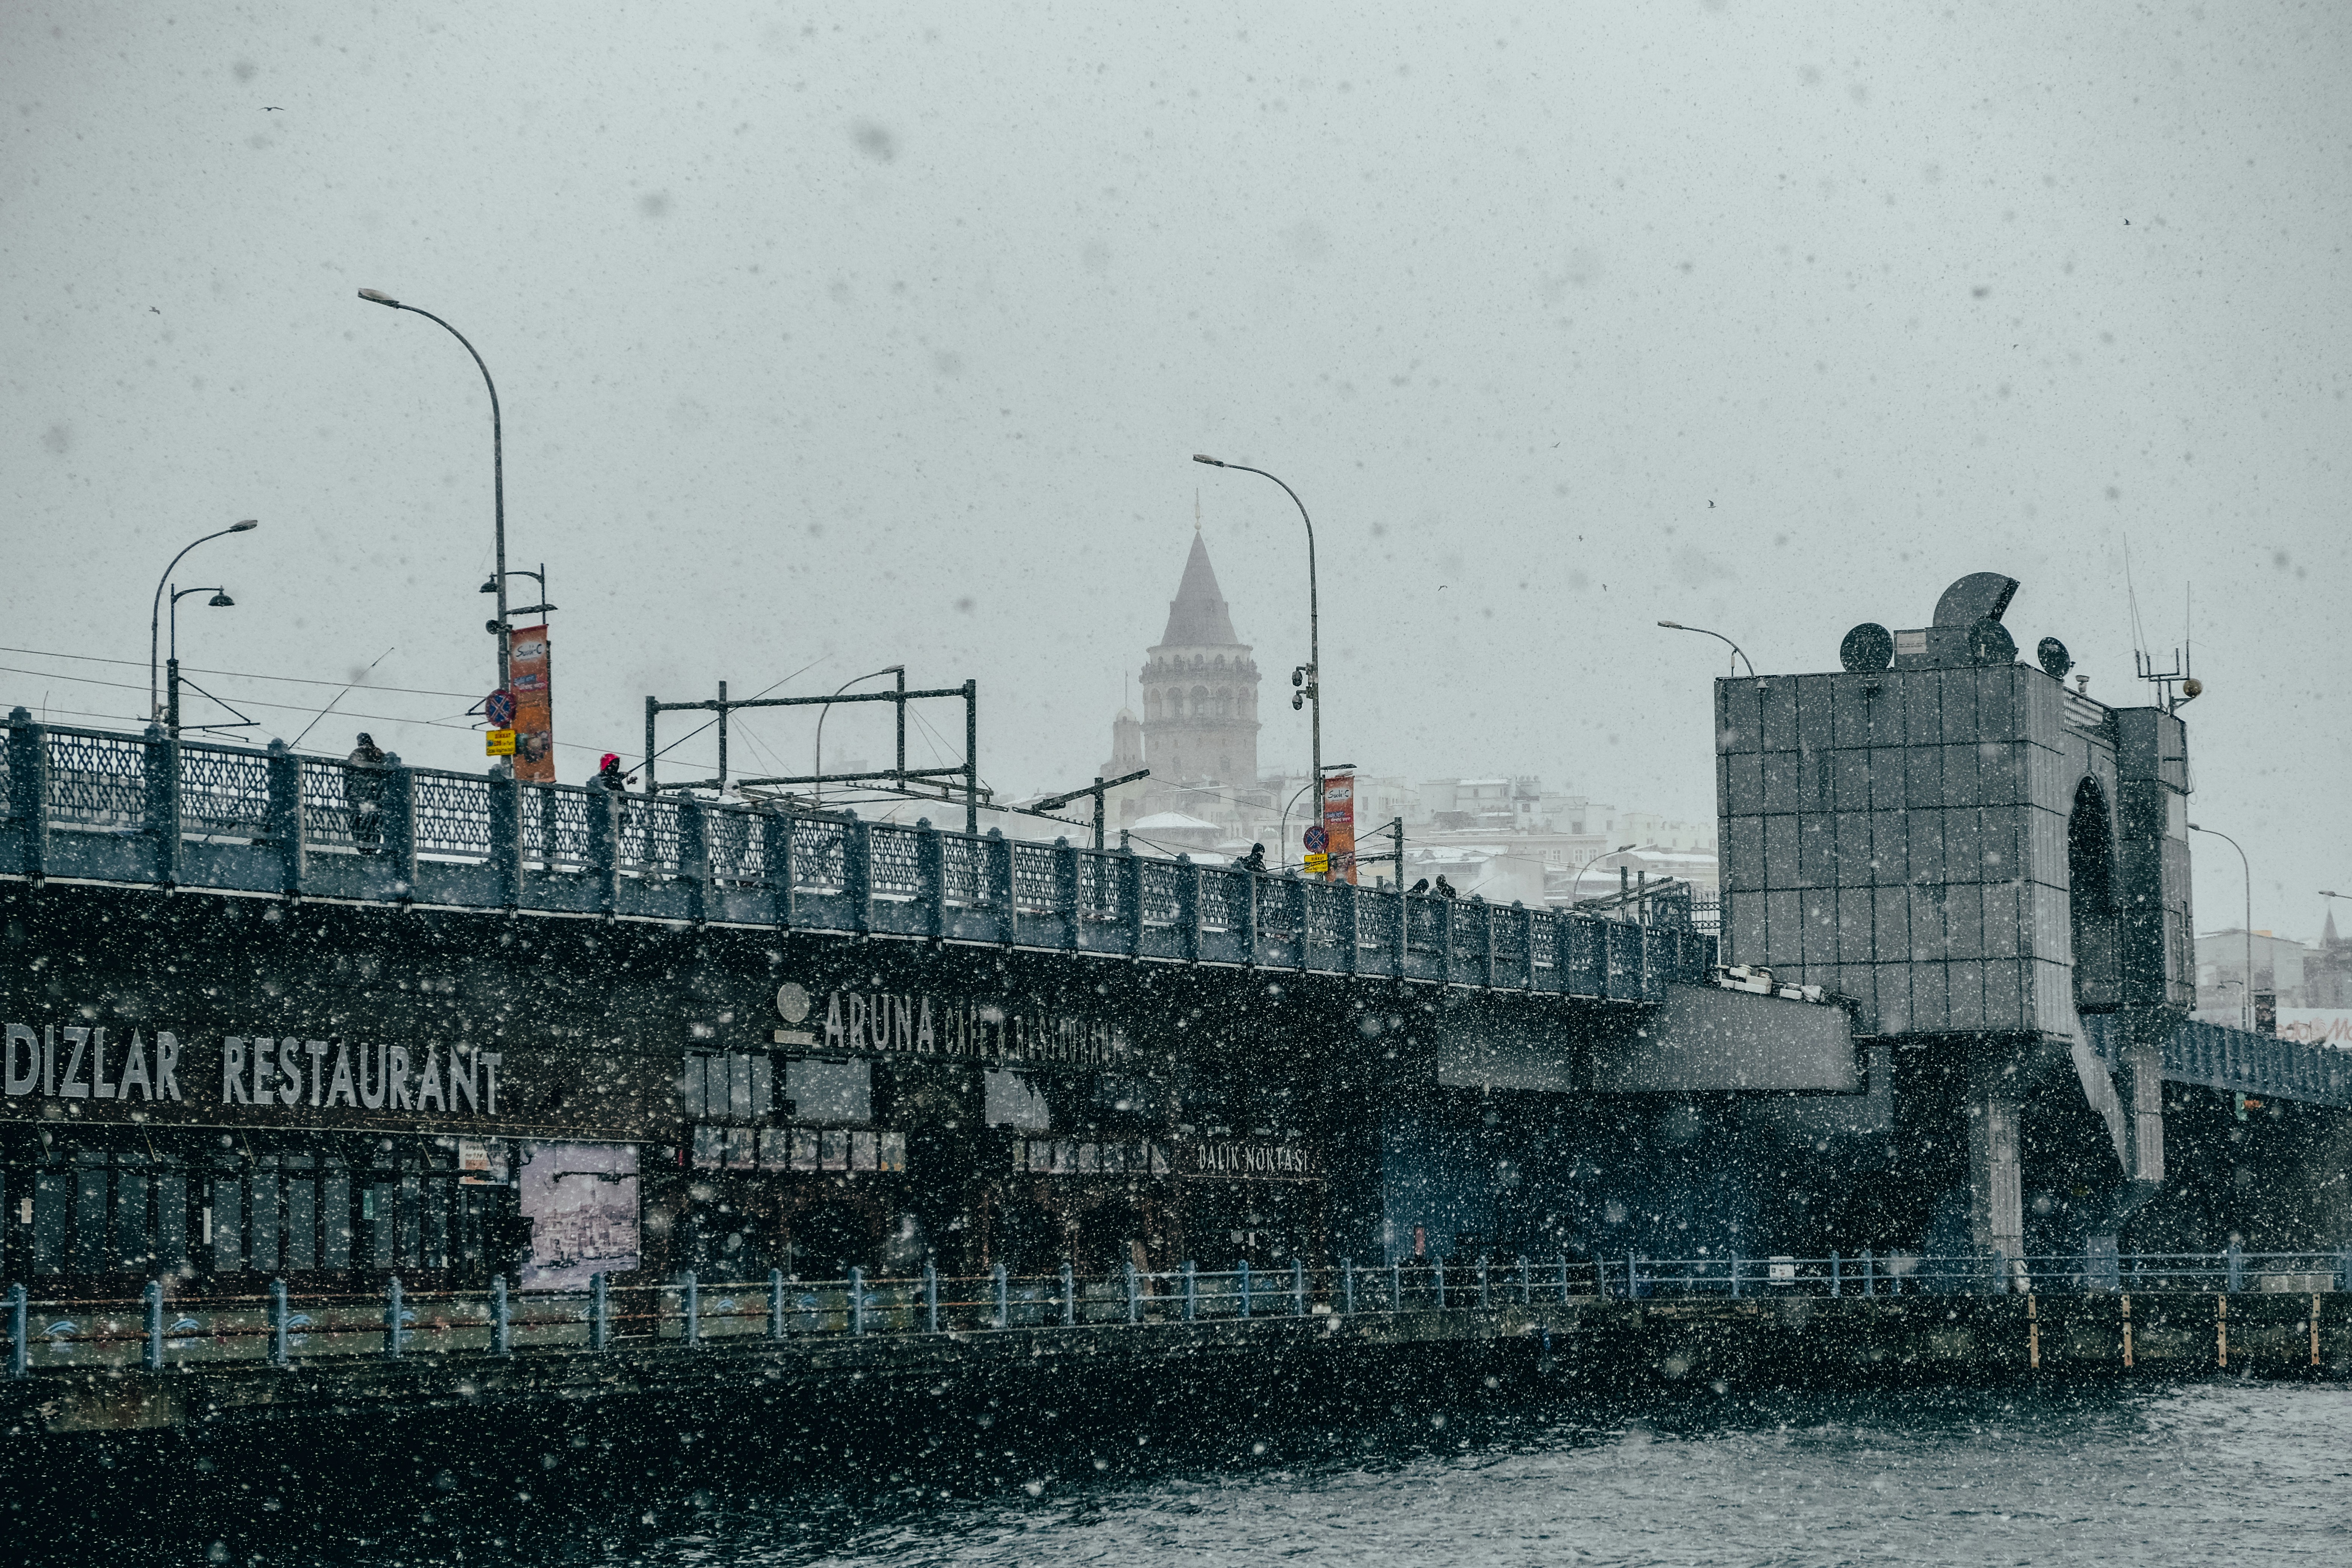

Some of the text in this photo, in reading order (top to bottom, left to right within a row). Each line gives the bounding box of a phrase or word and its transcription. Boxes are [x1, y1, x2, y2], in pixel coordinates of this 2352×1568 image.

[824, 991, 934, 1054] ARUNA
[945, 1007, 988, 1056] CAFE
[5, 1023, 502, 1115] DIZLAR RESTAURANT
[1198, 1144, 1307, 1172] BALIK NOKTASI
